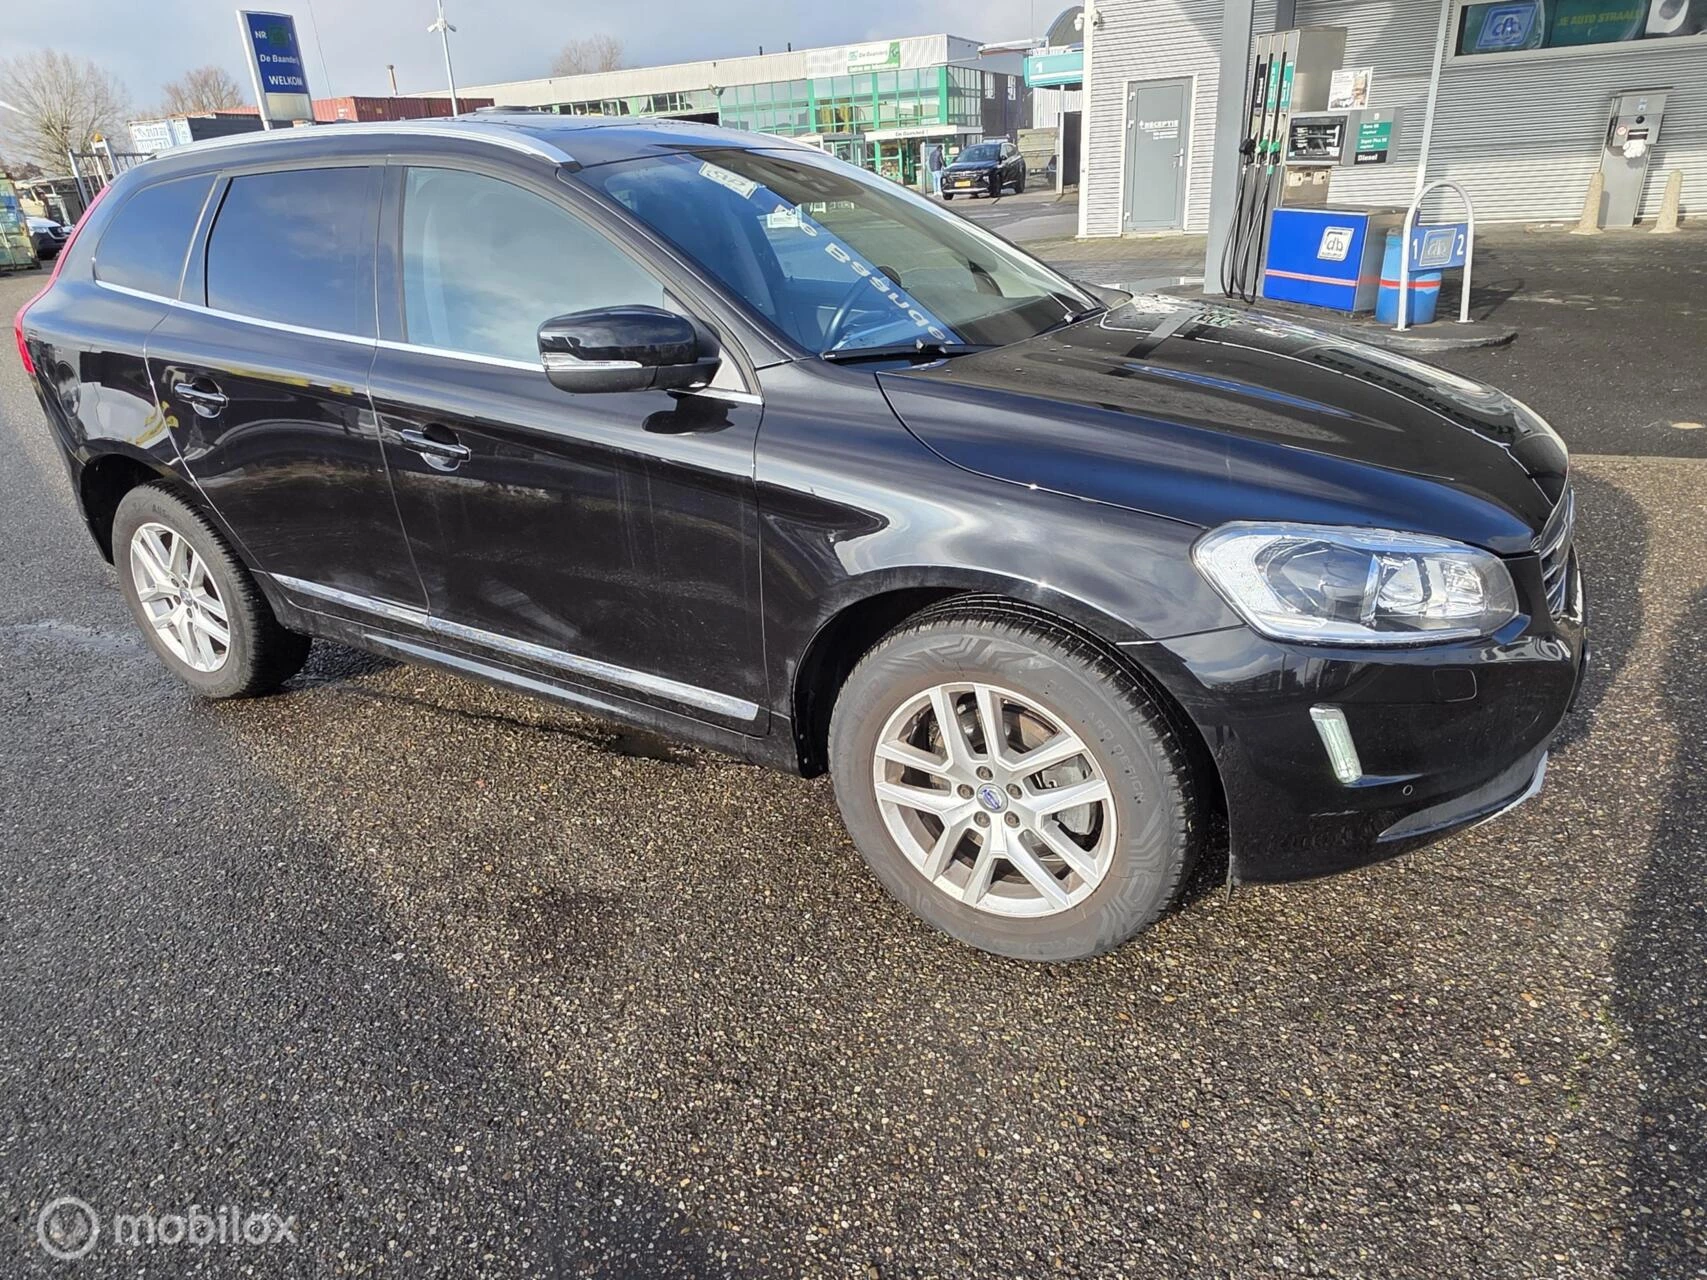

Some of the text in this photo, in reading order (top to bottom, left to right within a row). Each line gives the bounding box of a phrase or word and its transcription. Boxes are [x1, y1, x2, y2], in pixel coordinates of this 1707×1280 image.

[254, 30, 268, 39] NR
[260, 54, 271, 63] De
[268, 75, 303, 86] WELKOM
[1357, 153, 1378, 161] Diesel
[1412, 238, 1419, 260] 1
[1457, 234, 1465, 256] 2
